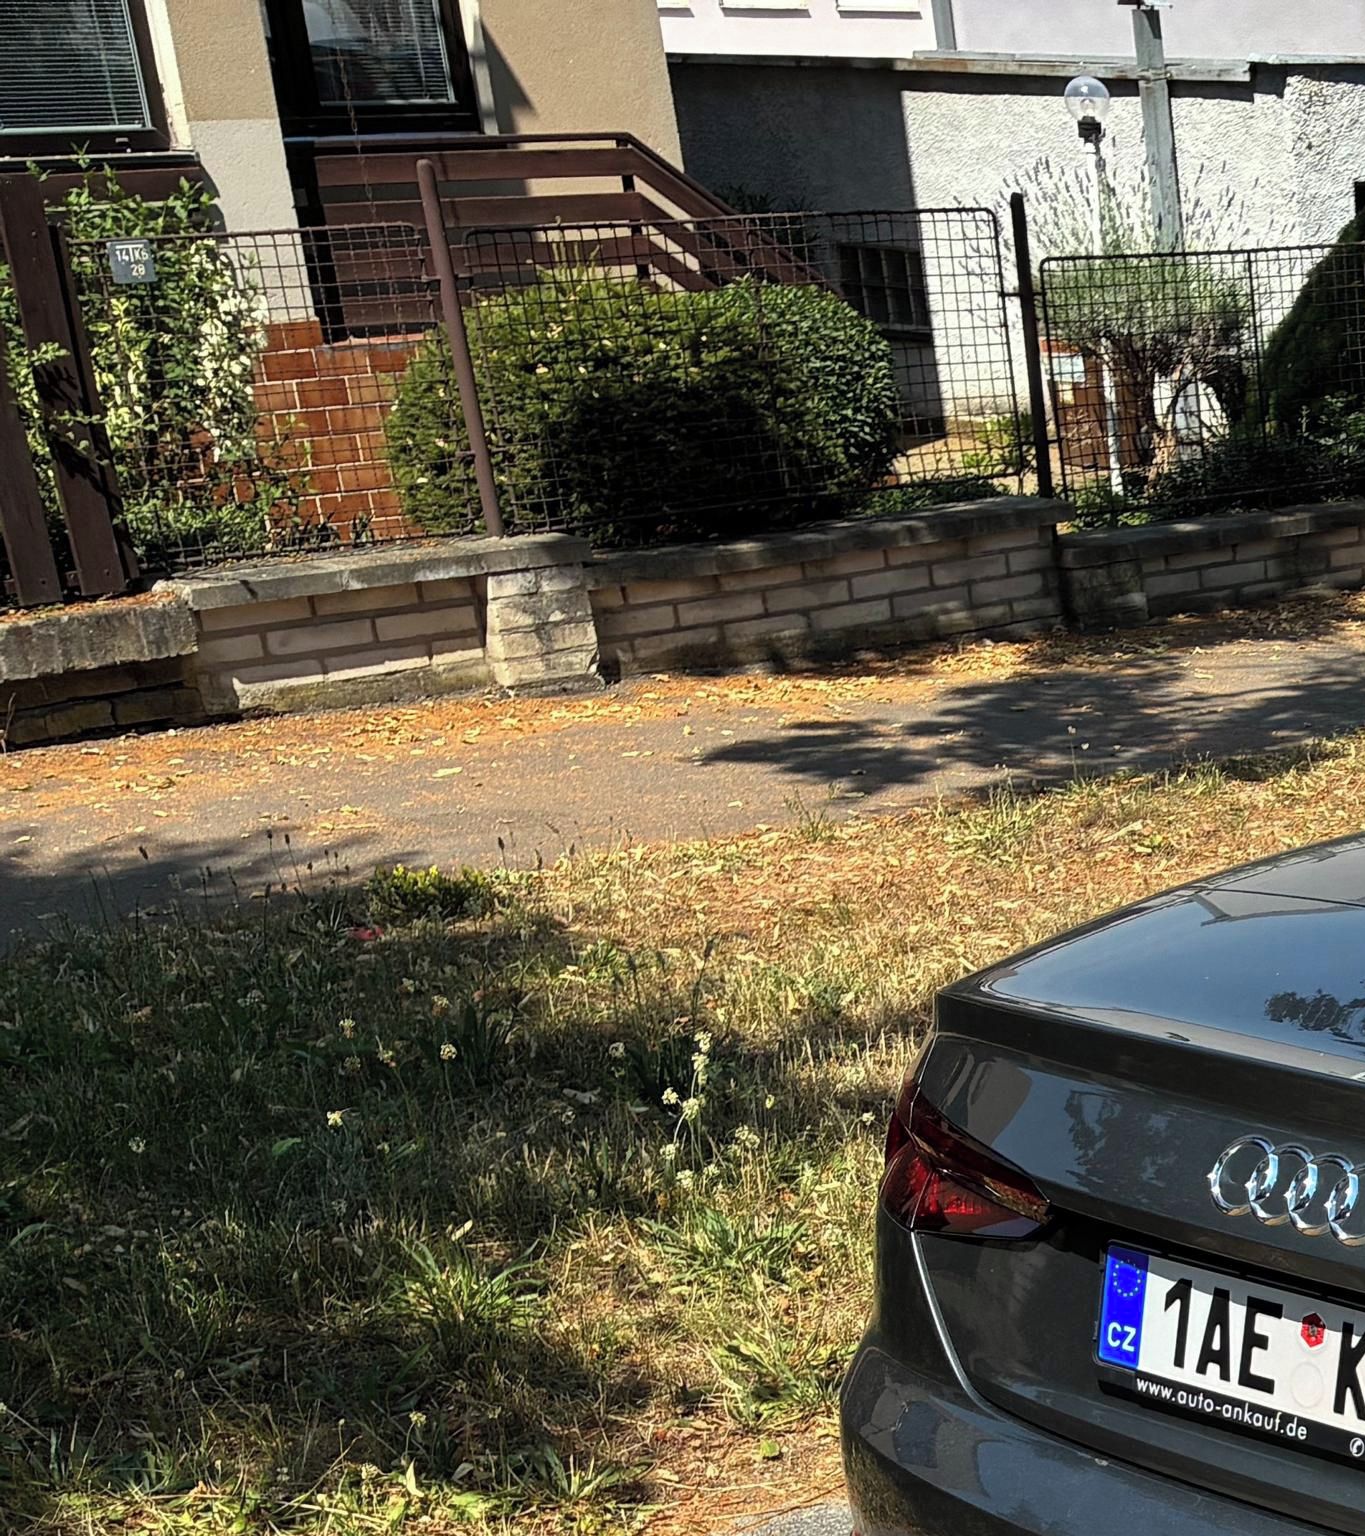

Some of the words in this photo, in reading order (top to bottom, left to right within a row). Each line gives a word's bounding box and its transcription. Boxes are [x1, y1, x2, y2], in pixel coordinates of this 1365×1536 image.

[130, 263, 146, 276] 28
[1107, 1322, 1136, 1351] CZ
[1164, 1278, 1283, 1394] 1AE
[1136, 1378, 1308, 1440] www.auto-ankauf.de
